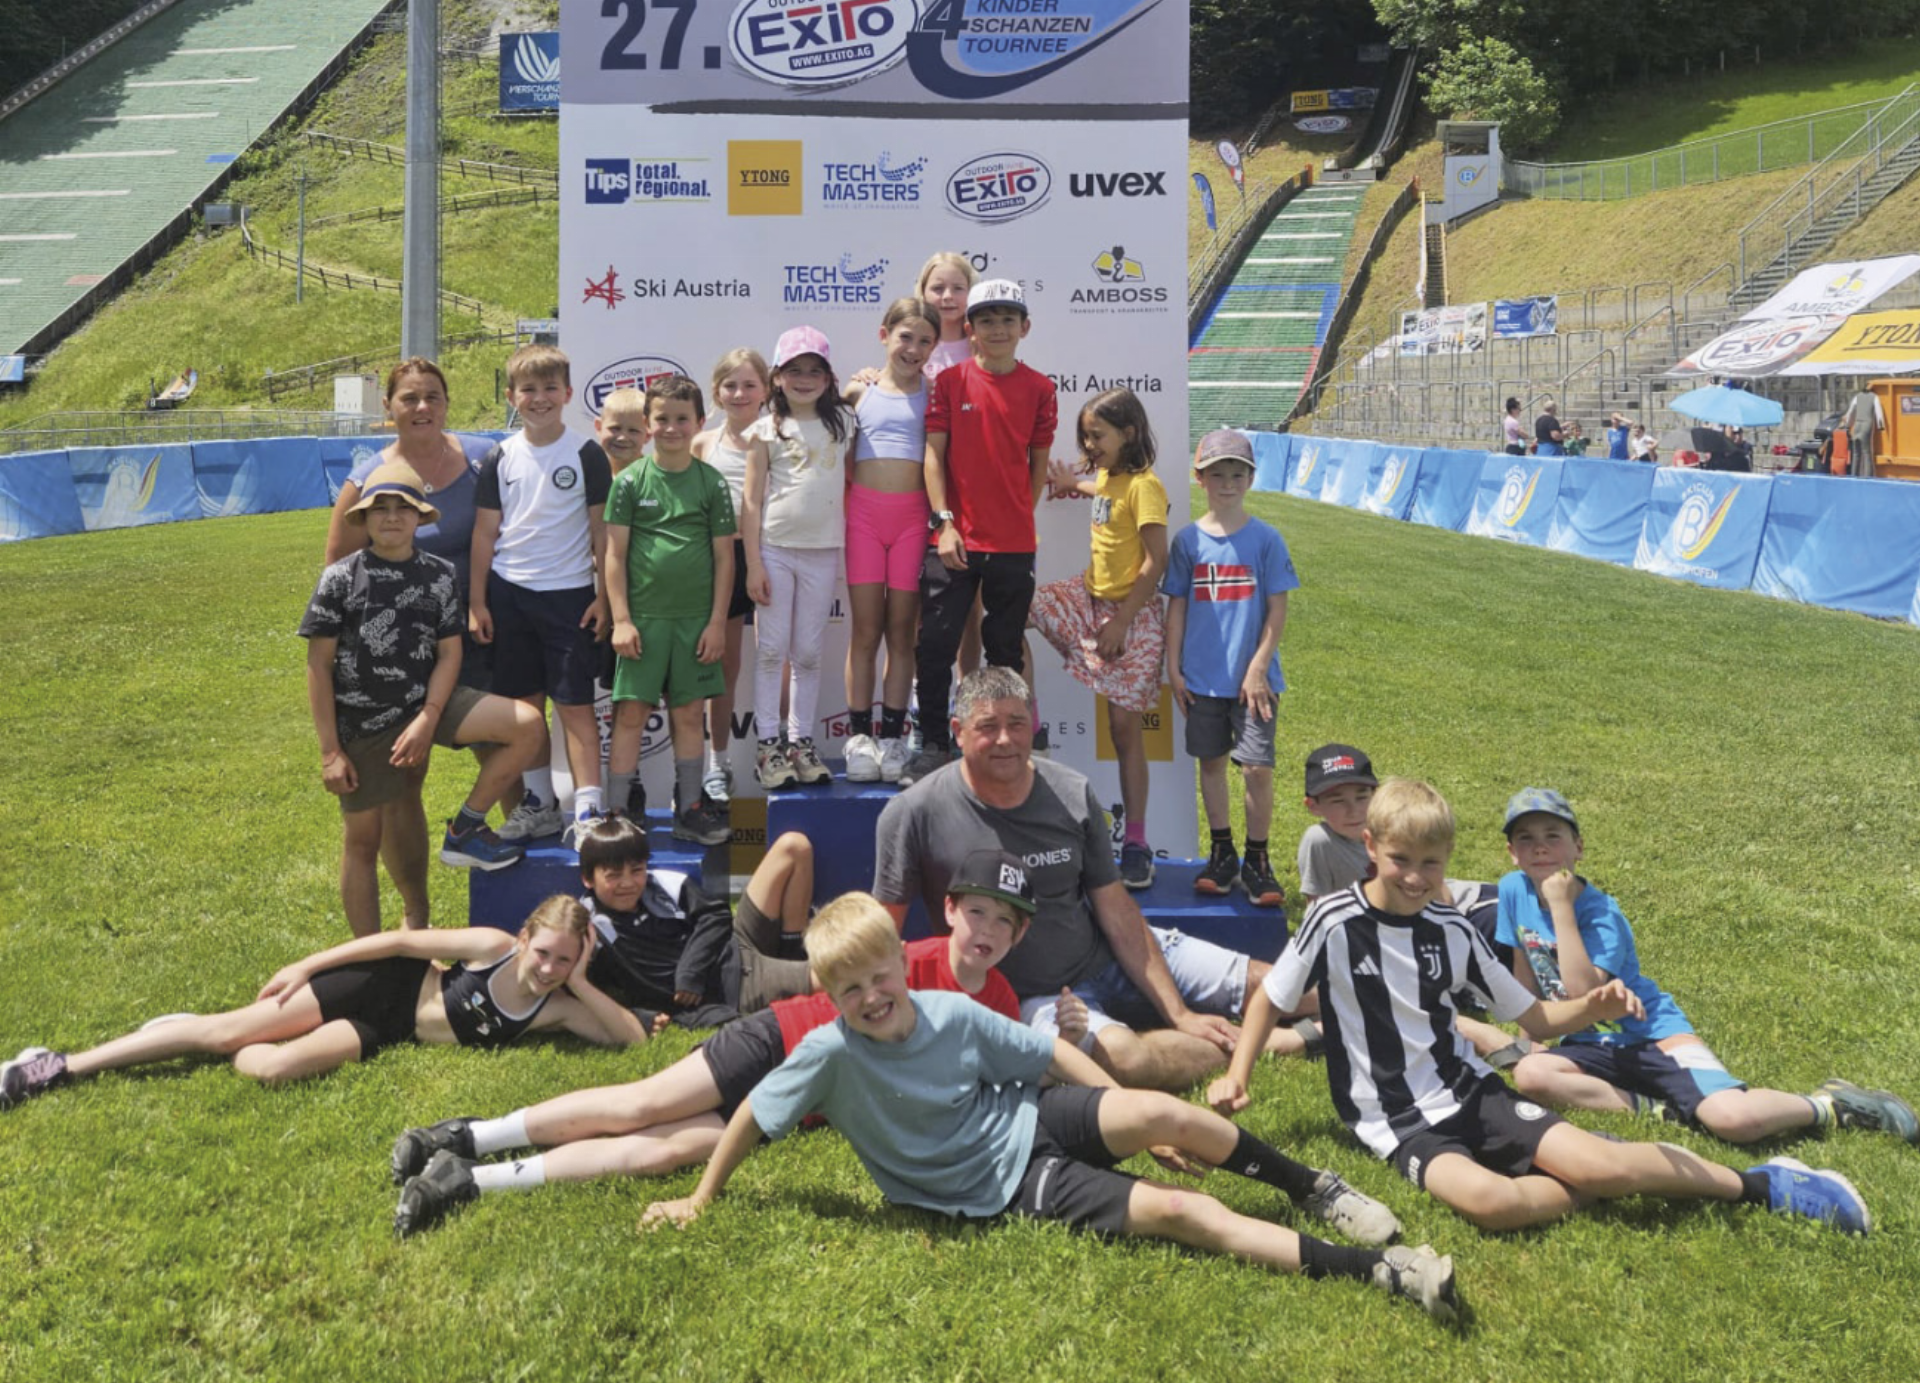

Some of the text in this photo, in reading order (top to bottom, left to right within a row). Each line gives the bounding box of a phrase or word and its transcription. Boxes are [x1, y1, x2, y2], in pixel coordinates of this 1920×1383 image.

[977, 0, 1059, 13] KINDER
[970, 17, 1091, 33] SCHANZEN
[600, 0, 721, 70] 27.
[964, 38, 1069, 53] TOURNEE
[791, 46, 872, 68] WWW.EXITO.AG
[636, 162, 681, 180] total.
[740, 169, 790, 183] YTONG
[823, 164, 876, 181] TECH
[586, 167, 628, 194] Tips
[636, 180, 711, 198] regional.
[1069, 171, 1167, 197] uvex
[823, 183, 920, 201] MASTERS
[784, 266, 837, 283] TECH
[633, 278, 751, 298] Ski Austria
[784, 285, 881, 303] MASTERS
[1070, 287, 1168, 303] AMBOSS
[1085, 374, 1162, 392] Austria
